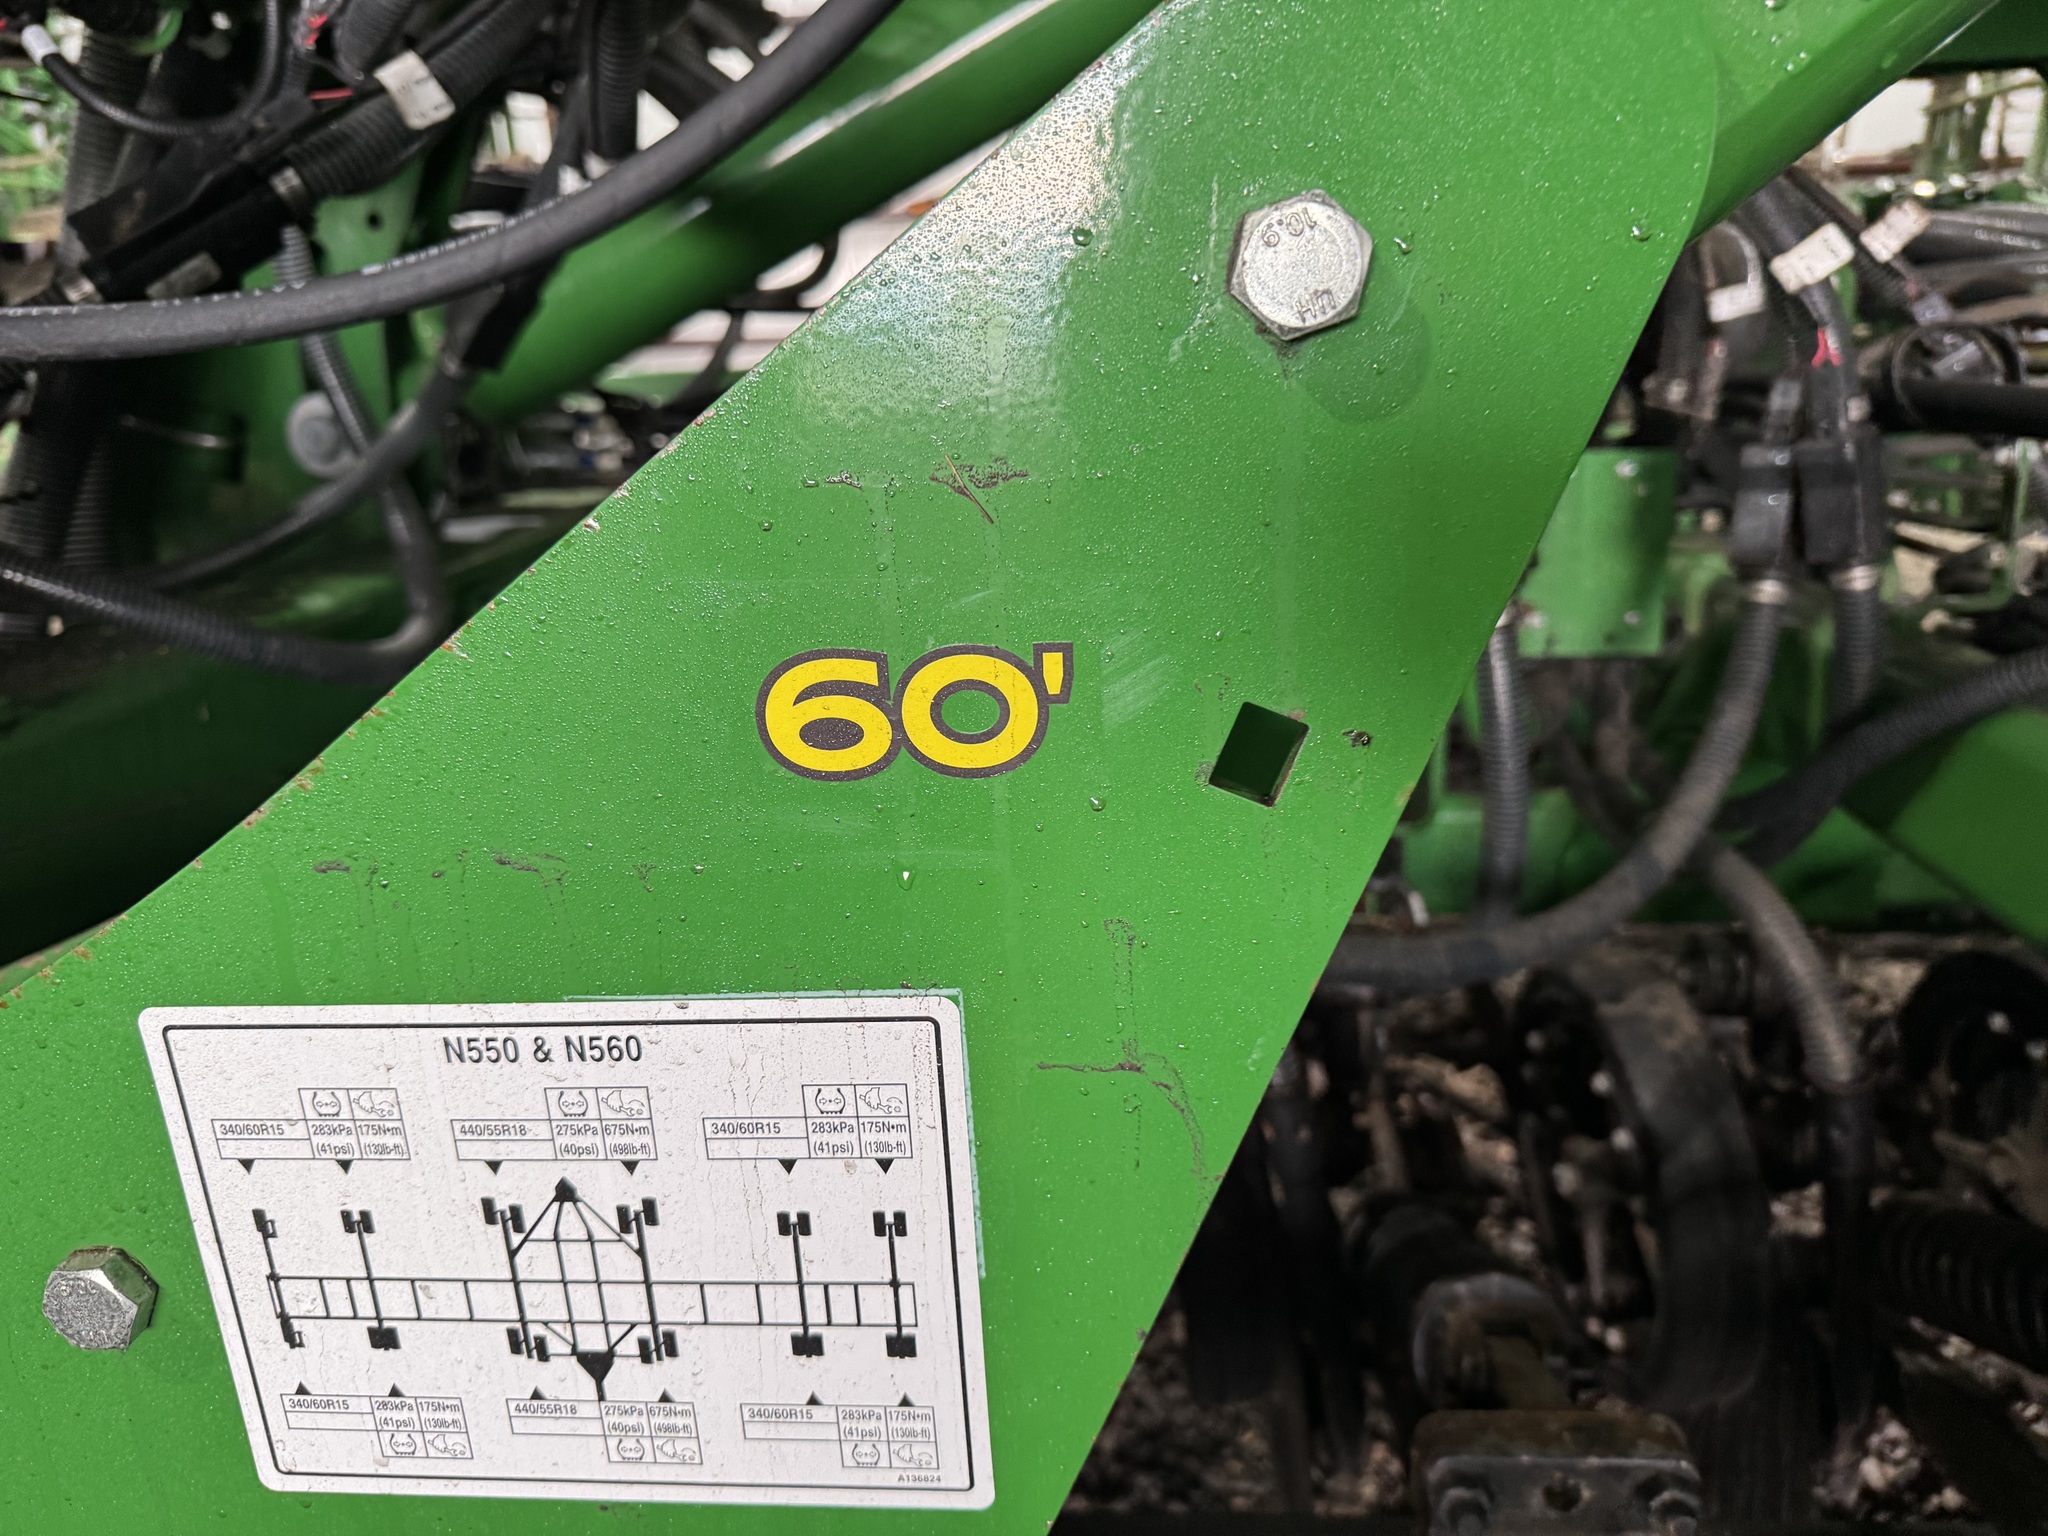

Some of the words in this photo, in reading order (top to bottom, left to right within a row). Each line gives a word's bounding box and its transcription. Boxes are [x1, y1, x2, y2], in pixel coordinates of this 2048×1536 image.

[755, 641, 1074, 782] 60'
[443, 1035, 520, 1063] N550
[533, 1035, 554, 1063] &
[565, 1034, 642, 1063] N560
[220, 1124, 284, 1136] 340/60R15
[311, 1124, 353, 1136] 283kPa
[459, 1124, 527, 1136] 440/55R18
[556, 1124, 599, 1136] 275kPa
[711, 1122, 781, 1134] 340/60R15
[811, 1121, 855, 1134] 283kPa
[316, 1143, 355, 1157] (41psi)
[364, 1143, 404, 1156] (130lb-ft)
[560, 1143, 599, 1158] (40psi)
[609, 1142, 651, 1157] (498lb-ft)
[813, 1140, 854, 1156] (41psi)
[864, 1140, 907, 1156] (130lb-ft)
[289, 1399, 349, 1410] 340/60R15
[375, 1400, 414, 1412] 283kPa
[515, 1403, 577, 1415] 440/55R18
[604, 1405, 644, 1416] 275kPa
[749, 1409, 813, 1420] 340/60R15
[842, 1409, 882, 1421] 283kPa
[379, 1417, 416, 1430] (41psi)
[424, 1418, 462, 1431] (130lb-ft)
[607, 1422, 645, 1436] (40psi)
[653, 1422, 693, 1436] (498lb-ft)
[843, 1426, 882, 1440] (41psi)
[891, 1426, 931, 1440] (130lb-ft)
[898, 1473, 941, 1483] A136824
